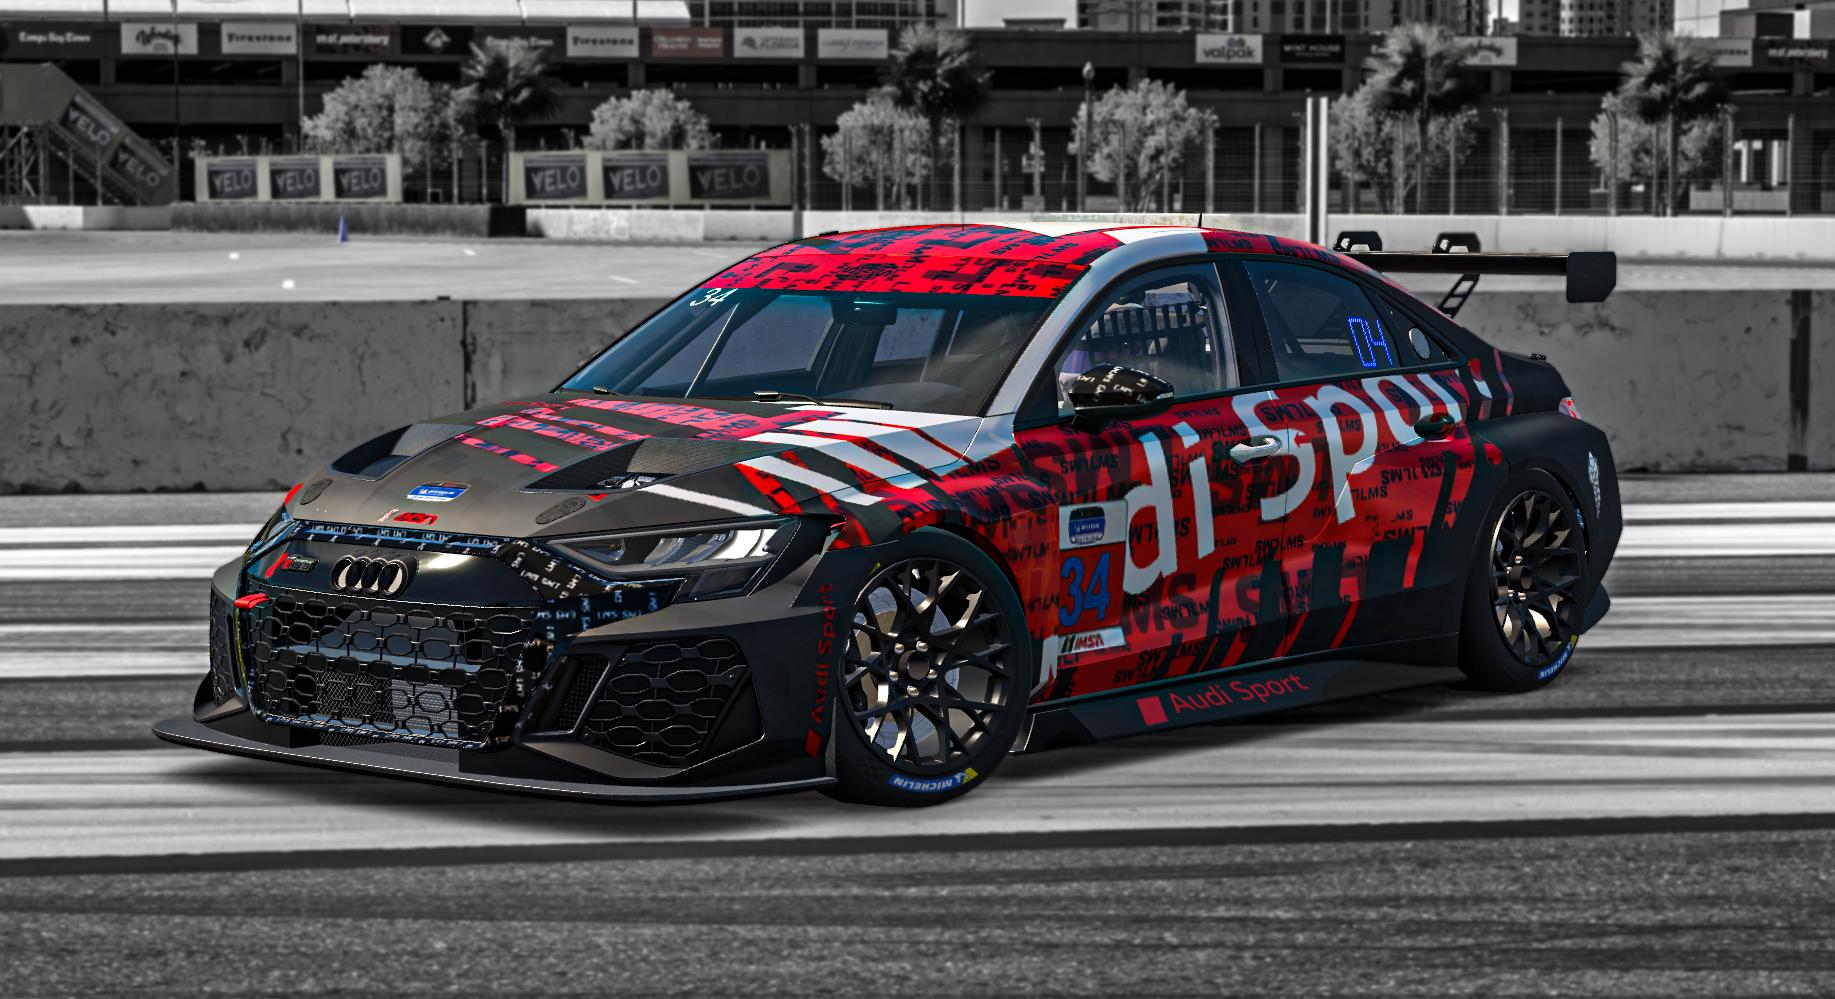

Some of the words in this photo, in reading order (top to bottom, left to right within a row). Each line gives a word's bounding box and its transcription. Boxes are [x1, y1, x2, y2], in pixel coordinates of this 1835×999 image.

[226, 32, 293, 43] Firestone
[571, 36, 634, 47] Firestone
[1203, 44, 1255, 61] valpak
[69, 108, 111, 146] VELO
[118, 151, 160, 188] VELO
[213, 169, 252, 193] VELO
[275, 168, 315, 192] VELO
[339, 167, 382, 191] VELO
[531, 165, 580, 193] VELO
[610, 165, 662, 192] VELO
[697, 164, 761, 192] VELO
[689, 287, 740, 308] 34
[1347, 317, 1393, 367] 04
[1059, 551, 1111, 628] 34
[816, 583, 837, 655] Sport
[1074, 633, 1105, 649] IMSA
[810, 663, 831, 725] Audi
[1168, 684, 1233, 714] Audi
[1229, 673, 1310, 703] Sport
[893, 776, 953, 792] MICHELIN
